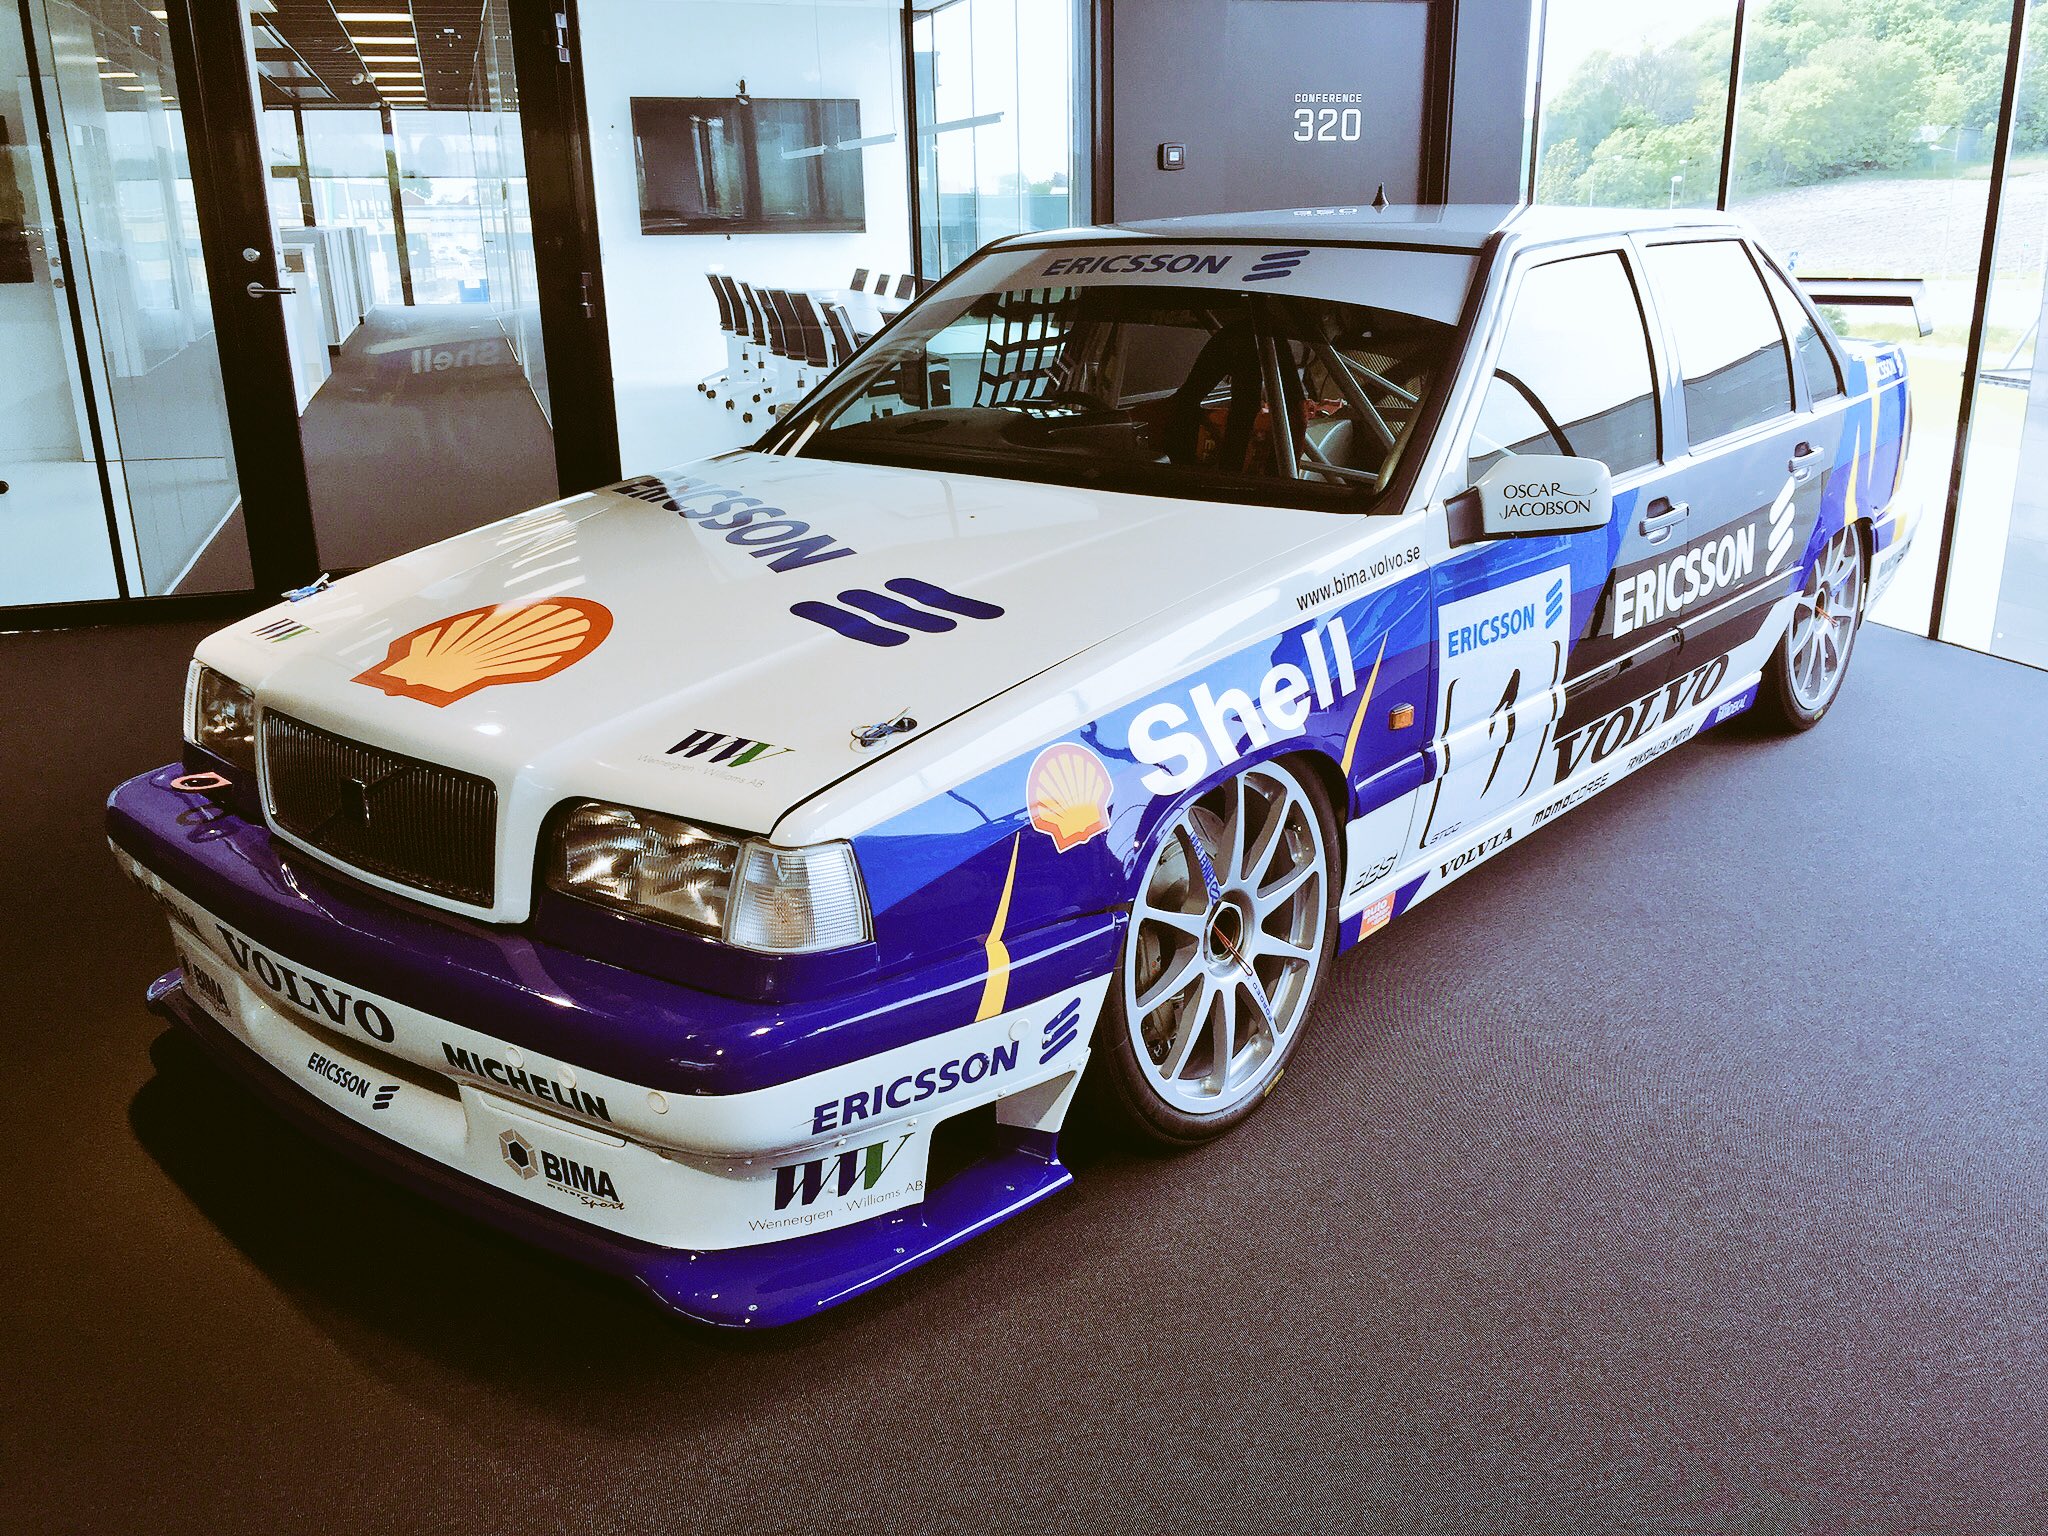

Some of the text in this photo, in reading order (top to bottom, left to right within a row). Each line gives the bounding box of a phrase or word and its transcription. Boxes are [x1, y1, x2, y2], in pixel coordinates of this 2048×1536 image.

[1293, 108, 1361, 141] 320
[1294, 93, 1362, 103] CONFERENCE
[1041, 254, 1232, 276] ERICSSON
[1499, 499, 1591, 520] JACOBSON
[1503, 482, 1598, 499] OSCAR
[1296, 546, 1420, 611] www.bima.volvo.se
[1613, 523, 1756, 640] ERICSSON
[1448, 603, 1536, 658] ERICSSON
[1127, 616, 1357, 796] Shell
[1553, 654, 1729, 785] VOLVO
[1440, 827, 1513, 879] VOLVIA
[215, 923, 395, 1043] VOLVO
[308, 1052, 371, 1099] ERICSSON
[441, 1041, 613, 1123] MICHELIN
[811, 1040, 1020, 1135] ERICSSON
[540, 1150, 621, 1203] BIMA
[748, 1207, 833, 1232] Wennergren
[846, 1188, 901, 1212] Williams
[904, 1180, 923, 1194] AB
